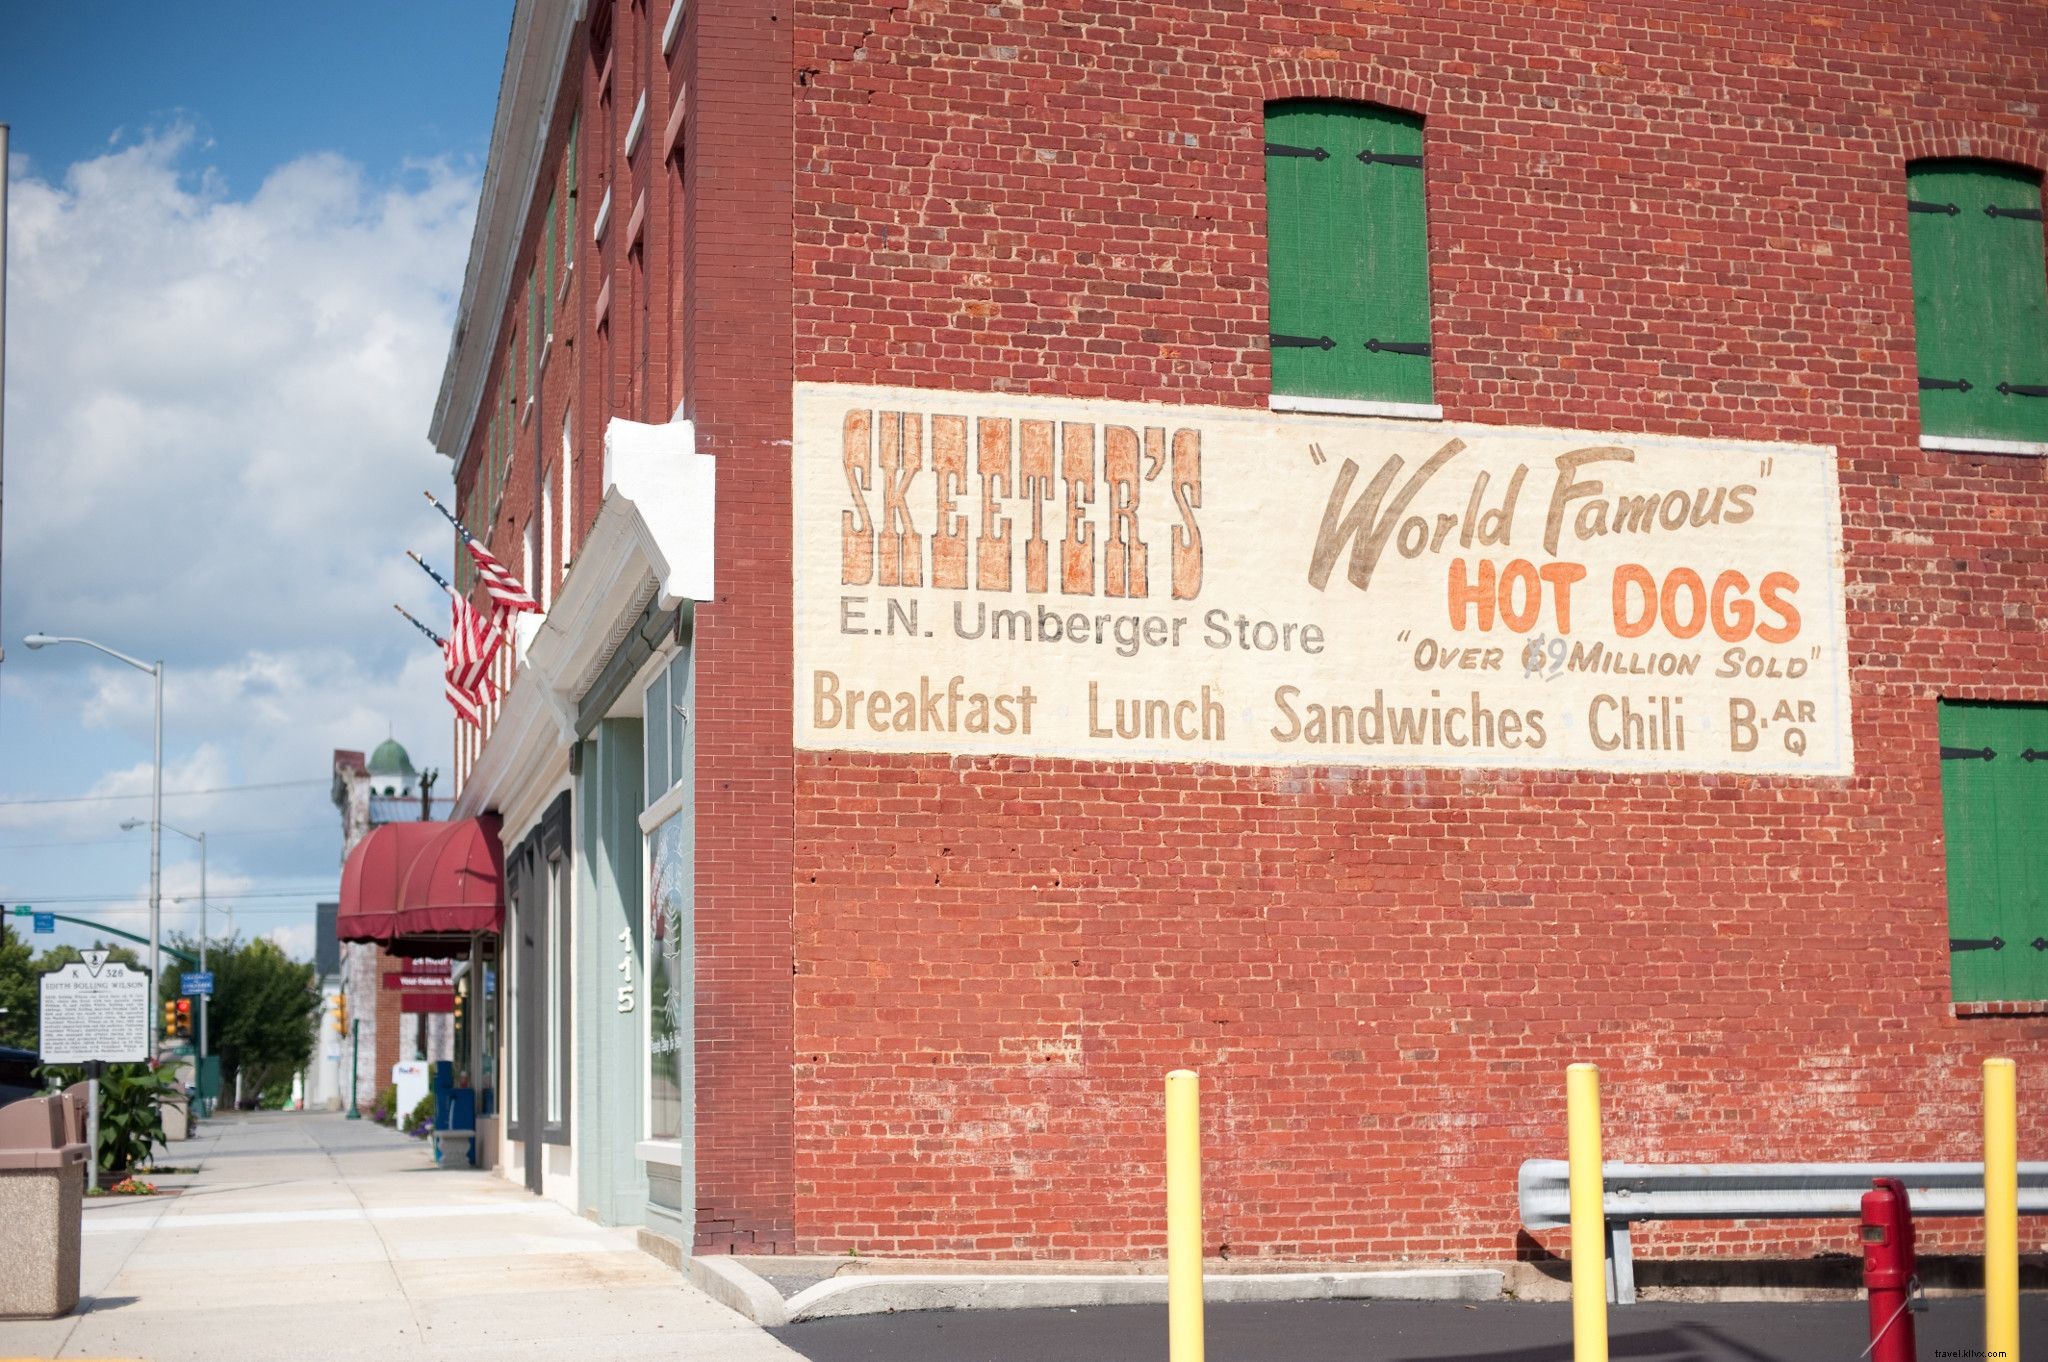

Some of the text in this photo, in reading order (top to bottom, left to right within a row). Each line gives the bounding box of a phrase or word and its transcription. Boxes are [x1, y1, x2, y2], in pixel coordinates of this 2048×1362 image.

[841, 408, 1203, 600] SKEETER'S
[840, 595, 1326, 657] E.N. Umberger Store
[1447, 557, 1801, 643] HOT DOGS
[813, 670, 1038, 736] Breakfast
[1088, 680, 1226, 742] Lunch
[1270, 685, 1547, 750] Sandwiches
[1588, 693, 1686, 752] Chili
[72, 969, 79, 979] K
